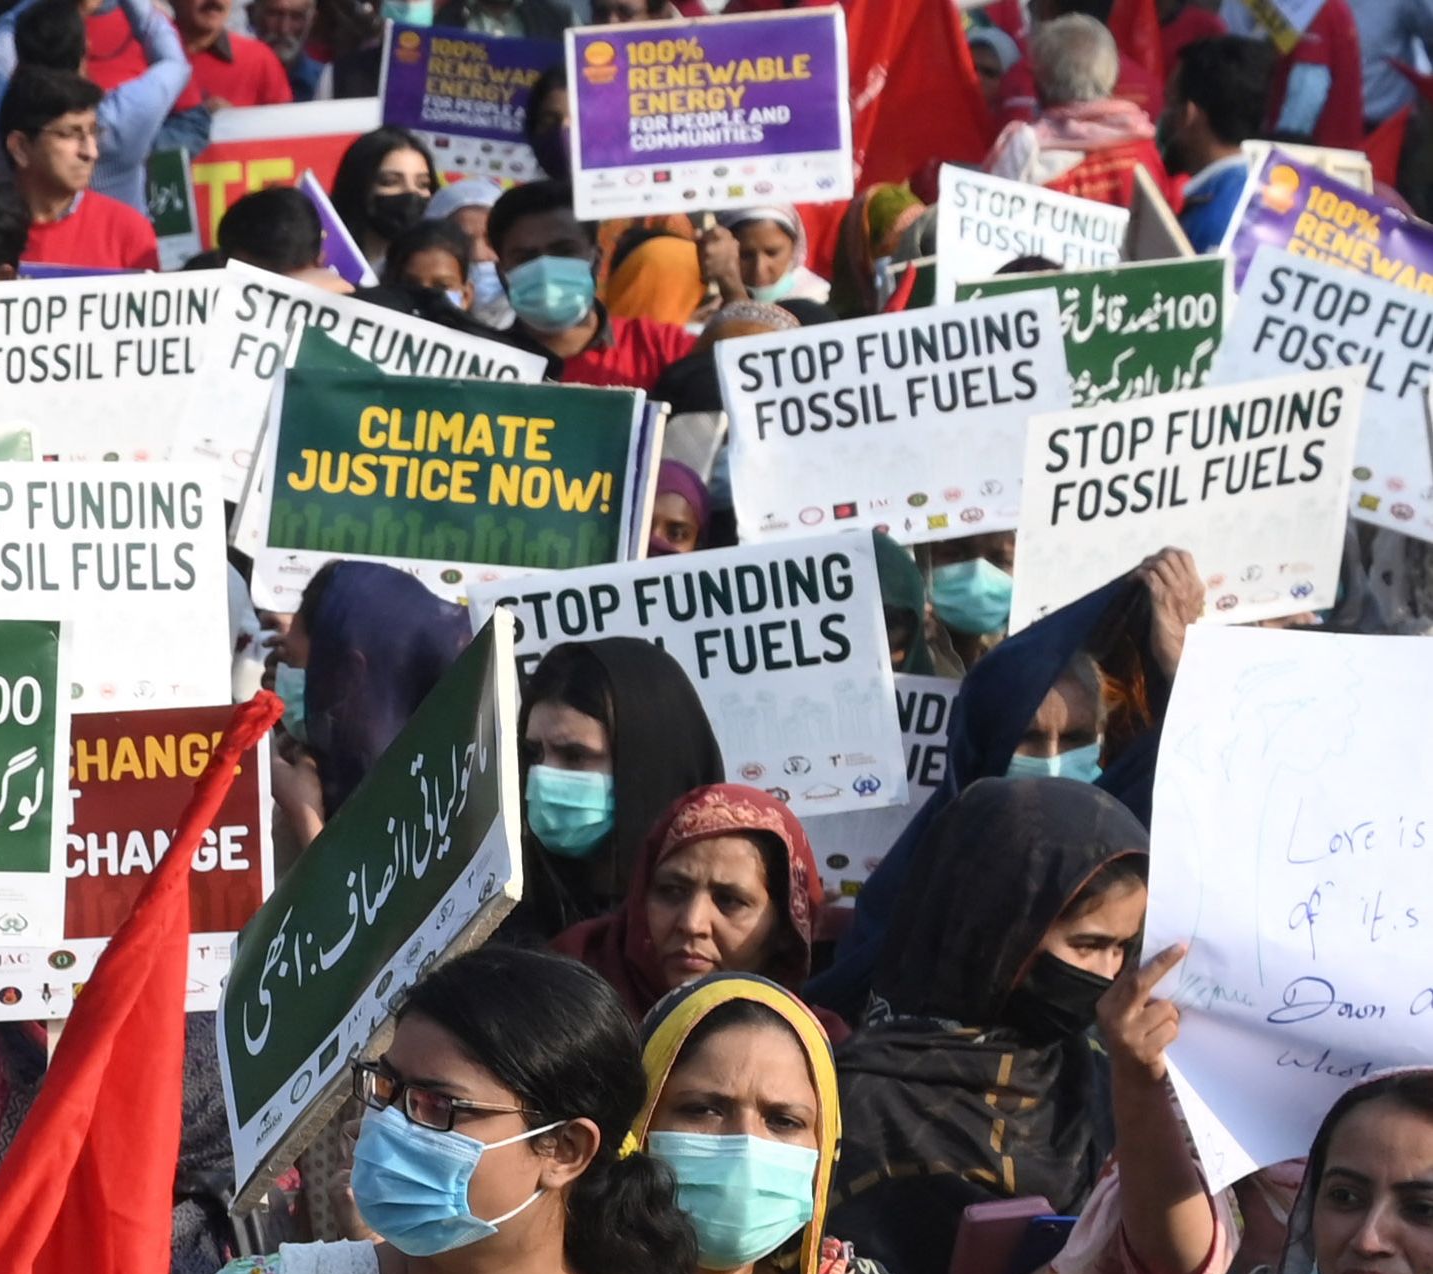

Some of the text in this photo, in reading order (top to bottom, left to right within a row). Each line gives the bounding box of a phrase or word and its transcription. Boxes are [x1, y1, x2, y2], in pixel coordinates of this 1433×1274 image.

[627, 37, 704, 65] 100%
[628, 53, 812, 91] RENEWABLE
[630, 85, 746, 118] ENERGY
[630, 105, 791, 134] FOR PEOPLE AND
[631, 127, 764, 153] COMMUNITIES
[1306, 184, 1383, 243] 100%
[1163, 293, 1218, 328] 100
[1261, 266, 1372, 328] STOP
[738, 309, 1042, 393] STOP FUNDING
[755, 357, 1038, 441] FOSSIL FUELS
[356, 405, 556, 462] CLIMATE
[1044, 384, 1344, 474] STOP FUNDING
[27, 480, 202, 530] FUNDING
[287, 450, 612, 515] JUSTICE NOW!
[1050, 439, 1325, 527] FOSSIL FUELS
[72, 542, 196, 591] FUELS
[634, 551, 855, 626] FUNDING
[697, 612, 853, 679] FUELS
